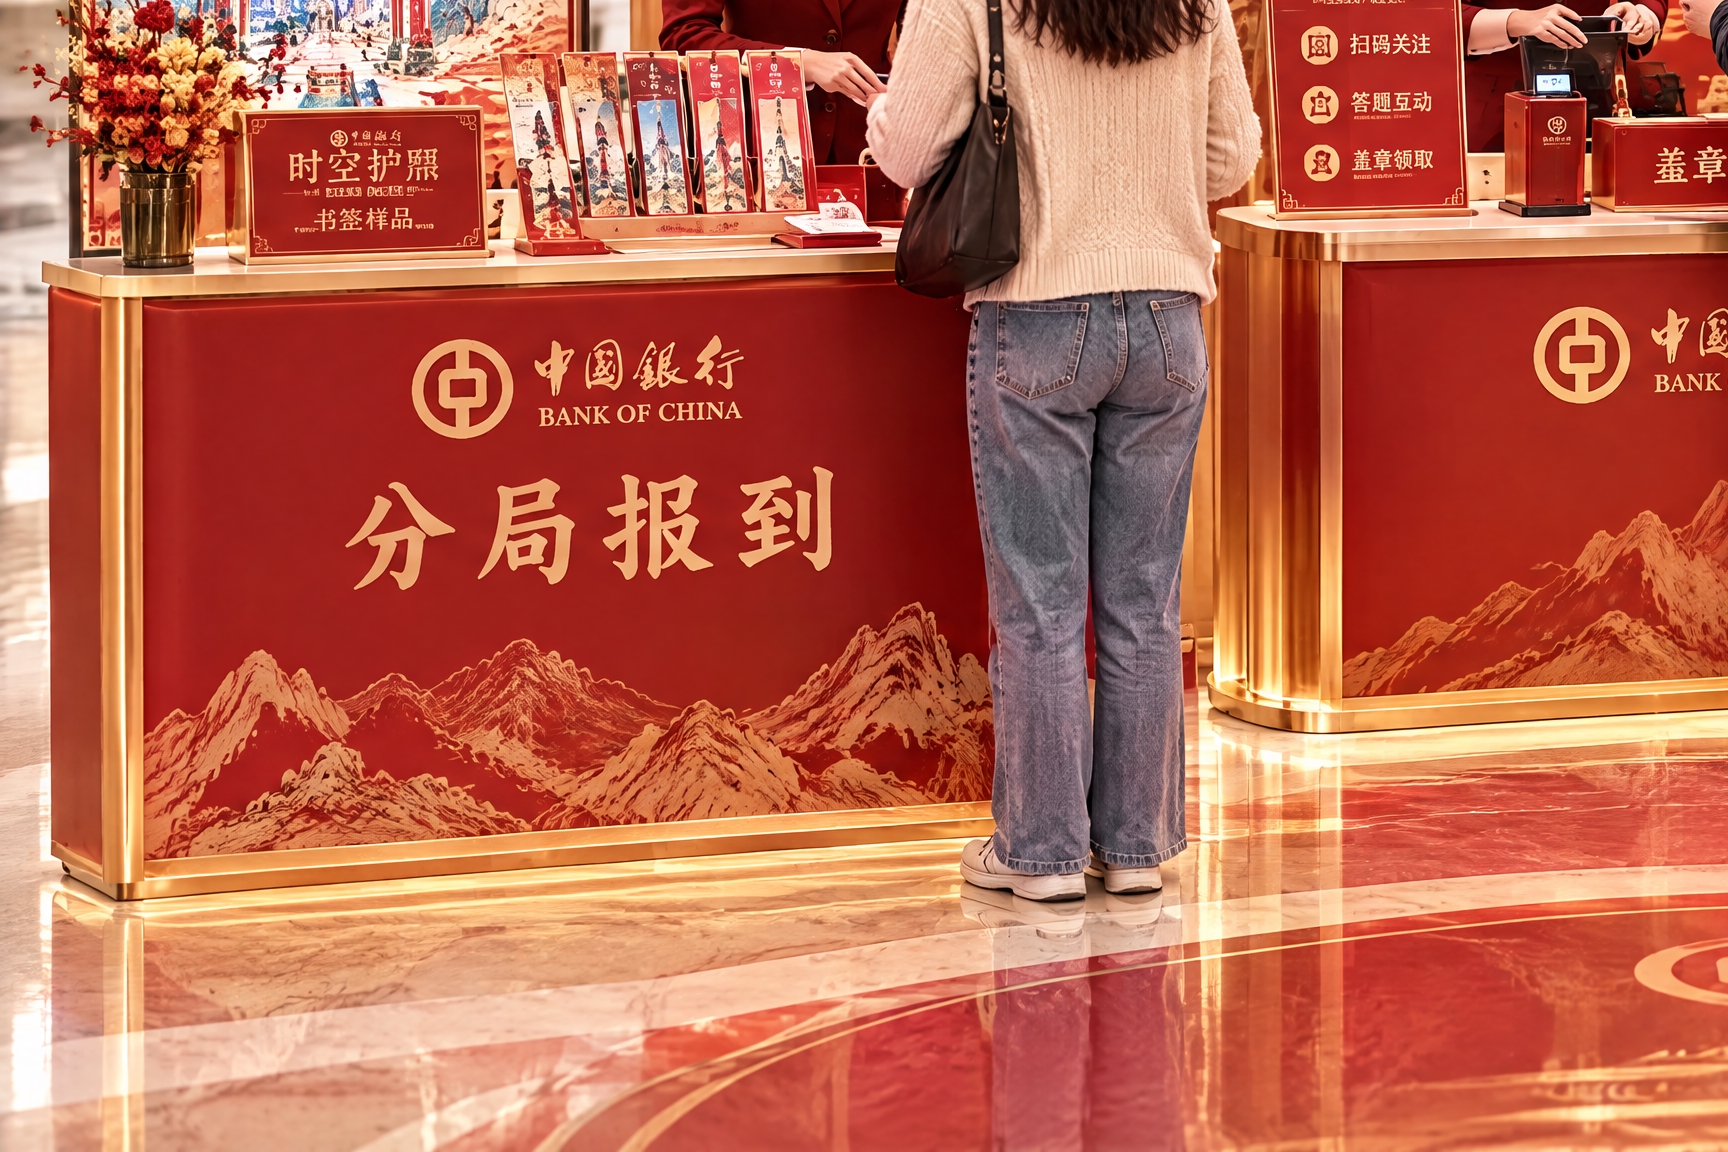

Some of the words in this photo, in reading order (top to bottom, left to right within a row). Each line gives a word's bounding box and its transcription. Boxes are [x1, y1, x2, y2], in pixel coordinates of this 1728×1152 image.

[1349, 33, 1431, 55] 扫码关注
[313, 207, 413, 233] 书签样品
[1655, 373, 1722, 392] BANK
[539, 406, 610, 426] BANK
[617, 404, 650, 423] OF
[659, 402, 742, 421] CHINA
[345, 466, 833, 590] 分局报到
